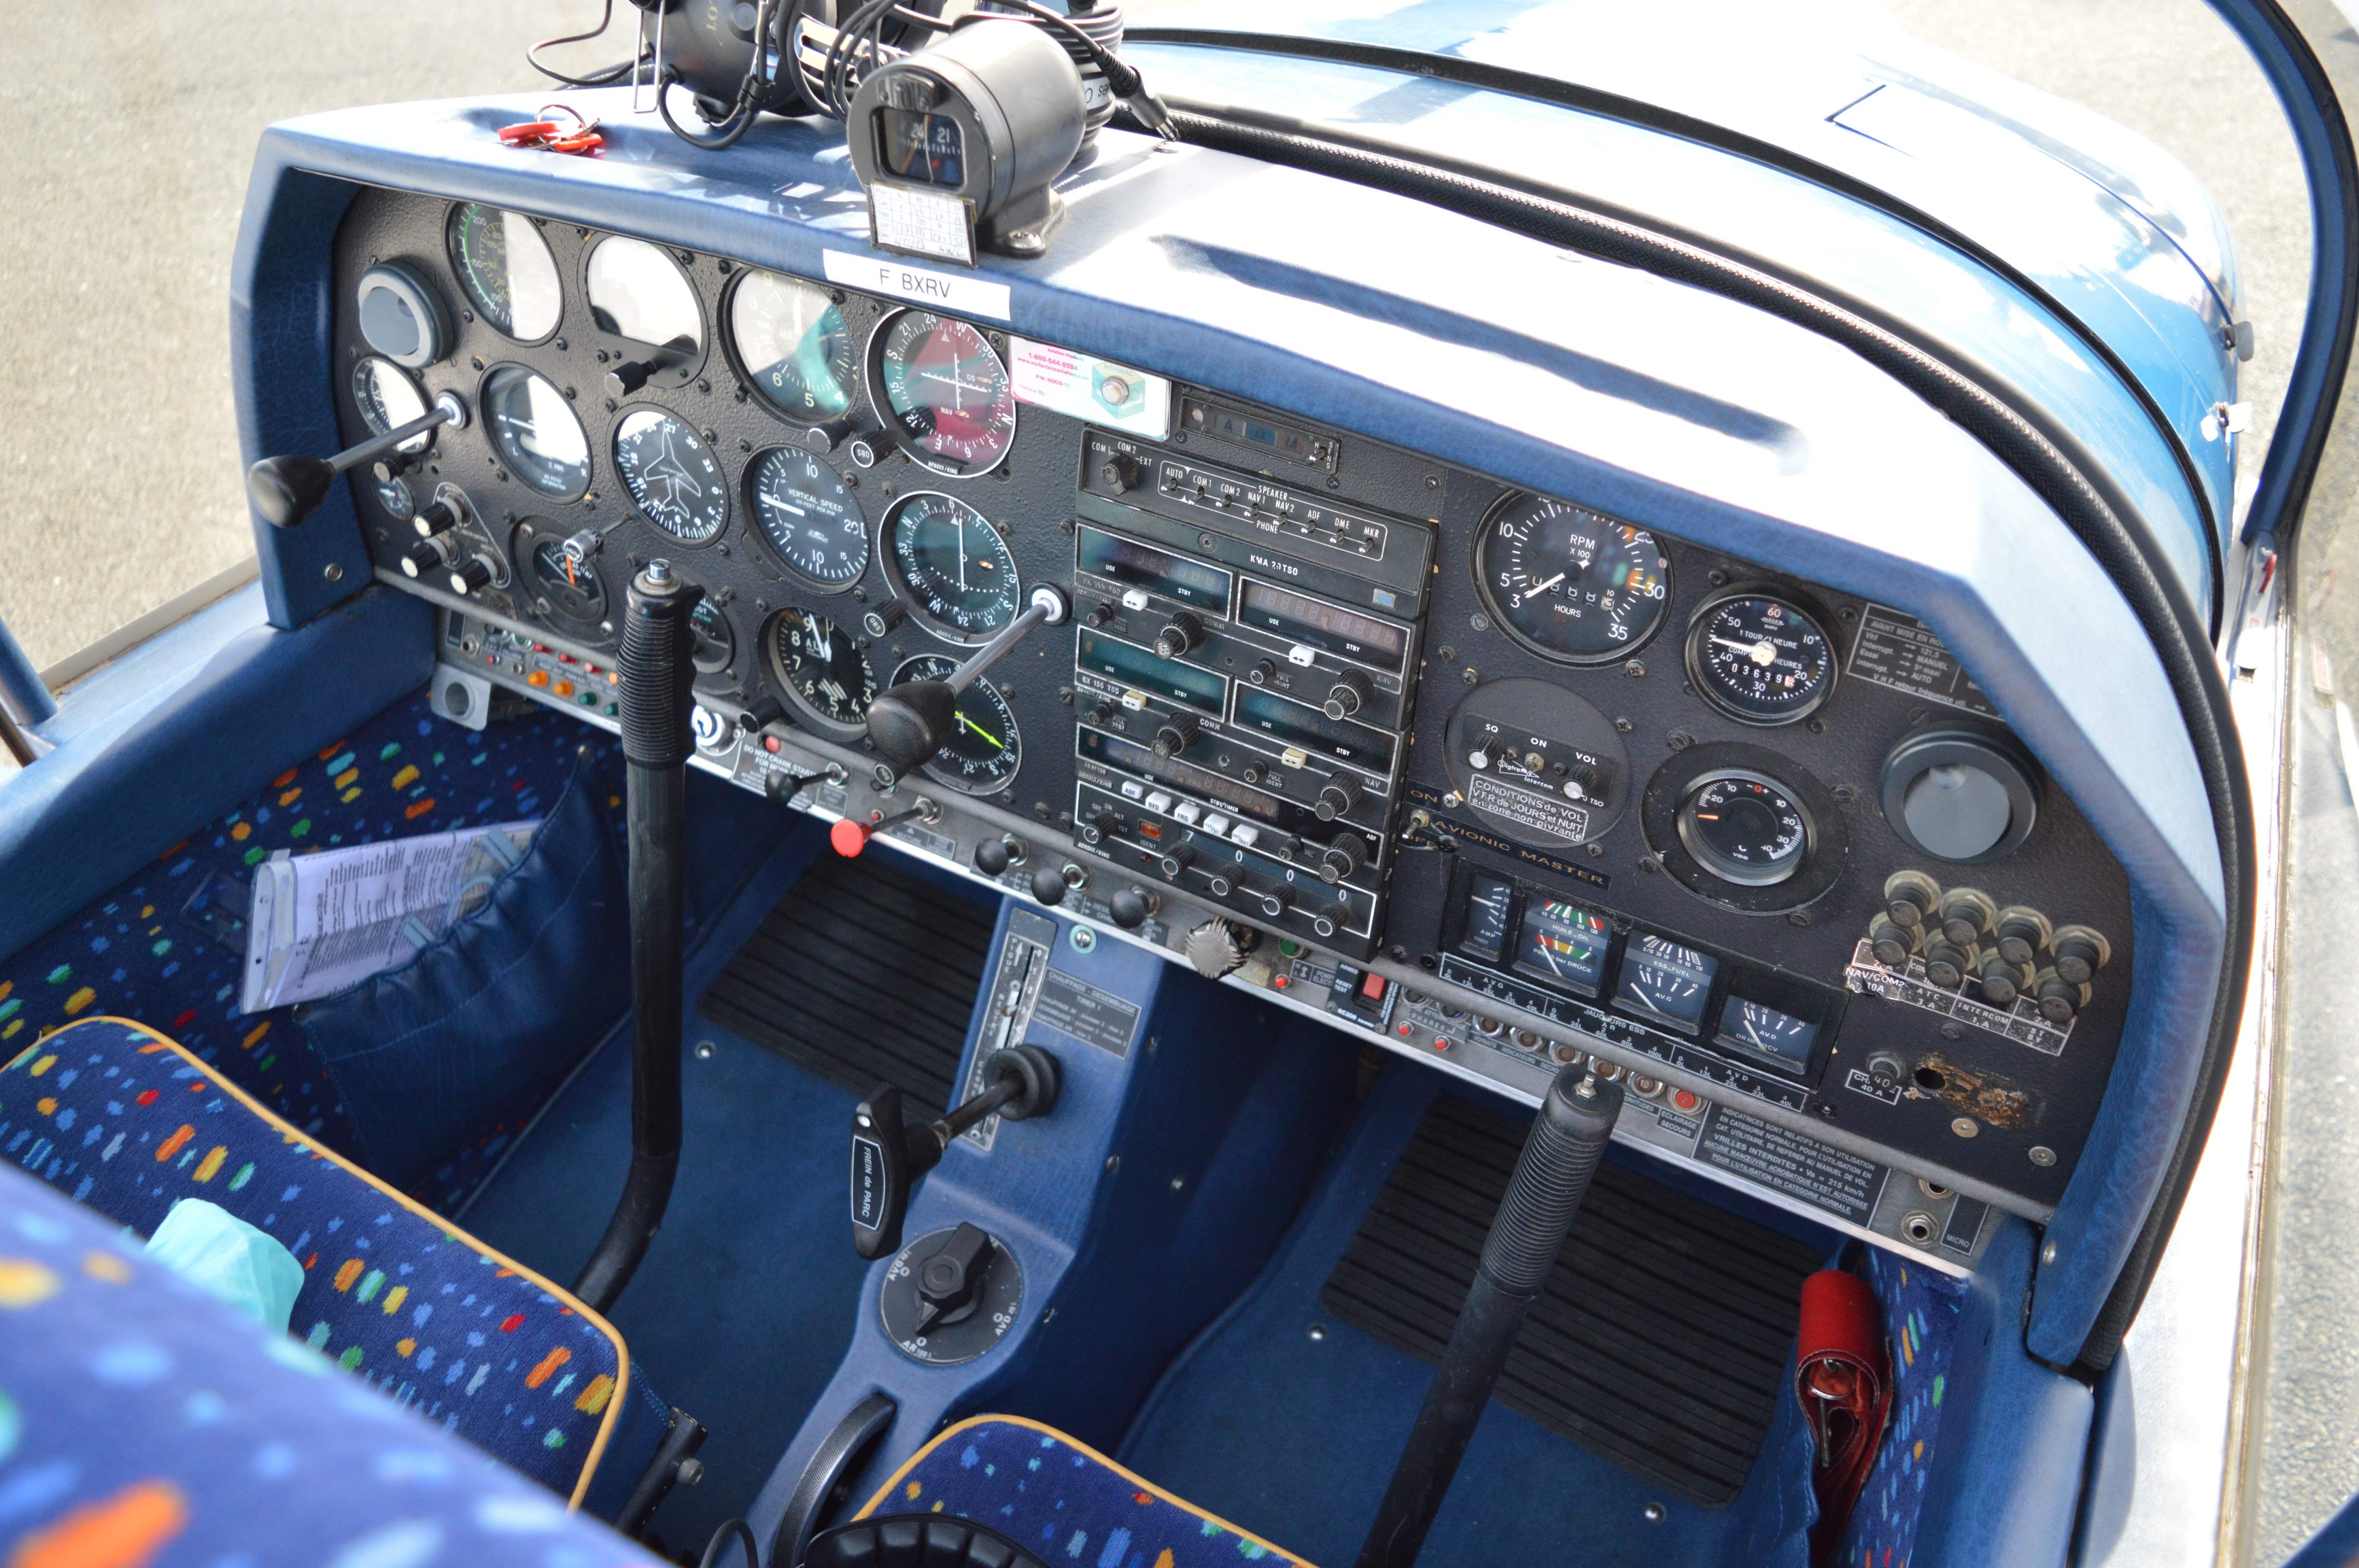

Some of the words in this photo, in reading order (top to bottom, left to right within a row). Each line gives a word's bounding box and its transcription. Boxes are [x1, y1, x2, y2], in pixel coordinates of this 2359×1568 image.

[938, 127, 949, 143] 21
[472, 216, 486, 226] 200
[880, 269, 891, 285] F
[902, 274, 951, 299] BXRV
[924, 313, 936, 324] 24
[899, 322, 911, 335] 21
[1029, 353, 1078, 371] 1-800-544-8594
[1104, 364, 1134, 376] NORMAL
[773, 373, 782, 387] 6
[941, 407, 953, 415] NAV
[857, 449, 870, 458] OBS
[1092, 442, 1106, 452] COM
[1118, 442, 1131, 452] COM
[703, 459, 713, 473] 33
[807, 463, 818, 477] 10
[928, 462, 958, 475] BENDIX/KING
[1166, 467, 1183, 479] AUTO
[1193, 475, 1207, 486] COM
[1221, 484, 1235, 494] COM
[1259, 486, 1288, 501] SPEAKER
[788, 489, 818, 503] VERTICAL
[821, 500, 842, 512] SPEED
[1248, 492, 1261, 503] NAV
[1275, 500, 1288, 511] NAV
[1308, 510, 1321, 520] ADF
[844, 519, 859, 534] 20
[1257, 520, 1278, 534] PHONE
[1335, 518, 1350, 529] DME
[1499, 522, 1514, 538] 10
[1364, 527, 1379, 538] MKR
[1570, 534, 1595, 550] RPM
[899, 543, 908, 555] 33
[1577, 549, 1590, 559] 100
[1250, 554, 1268, 567] KMA
[1282, 564, 1298, 576] TSO
[1500, 573, 1510, 587] 5
[1178, 588, 1191, 596] STBY
[1644, 582, 1665, 600] 30
[1554, 604, 1581, 618] HOURS
[1767, 608, 1781, 617] 60
[870, 617, 881, 631] OBS
[1728, 617, 1741, 627] 50
[1608, 624, 1627, 640] 35
[1871, 621, 1895, 632] AVANT
[1896, 628, 1915, 640] MISE
[792, 631, 800, 646] 8
[1745, 631, 1763, 640] TOUR
[1773, 638, 1798, 649] HEURE
[1804, 635, 1814, 644] 10
[1346, 643, 1360, 652] STBY
[793, 655, 801, 670] 7
[1774, 658, 1802, 670] HEURES
[1917, 656, 1948, 670] MANUEL
[1911, 673, 1932, 683] AUTO
[1083, 676, 1091, 684] KX
[1094, 680, 1104, 689] 155
[1108, 685, 1119, 694] TSO
[1753, 681, 1766, 691] 30
[1174, 690, 1187, 698] STBY
[1895, 681, 1917, 691] retour
[1917, 687, 1954, 703] fréquence
[1200, 718, 1220, 731] COMM
[1486, 724, 1498, 733] SQ
[1531, 738, 1547, 747] ON
[744, 745, 754, 753] DO
[755, 749, 768, 759] NOT
[770, 754, 792, 768] CRANK
[1336, 747, 1350, 756] STBY
[1576, 753, 1596, 765] VOL
[880, 768, 890, 781] HDG
[1268, 773, 1281, 782] PULL
[1266, 779, 1282, 789] IDENT
[1365, 778, 1380, 788] NAV
[1524, 777, 1553, 790] Intercom
[1411, 790, 1437, 802] ON
[1475, 780, 1543, 808] CONDITIONS
[1544, 804, 1556, 814] de
[1561, 809, 1582, 822] VOL
[1590, 798, 1603, 807] TSO
[1148, 802, 1159, 810] BFO
[1210, 798, 1238, 813] STBY/TIMER
[1488, 803, 1512, 817] zone
[1514, 811, 1533, 824] non
[1537, 819, 1582, 840] givrante
[1511, 799, 1546, 820] JOURS
[1547, 815, 1556, 824] et
[1558, 817, 1582, 832] NUIT
[1140, 840, 1156, 849] IDENT
[1777, 836, 1789, 844] 30
[1078, 842, 1110, 859] BENDIX/KING
[1435, 821, 1511, 851] AVIONIC
[1521, 850, 1603, 884] MASTER
[1480, 929, 1496, 938] AMP
[1340, 964, 1358, 974] ARMED
[1555, 956, 1566, 965] bar
[1567, 960, 1591, 973] DRÜCK
[1049, 972, 1086, 992] CHAUFFAGE
[1336, 979, 1352, 989] RESET
[1845, 968, 1905, 988] NAV/COM2
[1867, 982, 1884, 993] 10A
[1077, 996, 1096, 1008] TIRER
[1338, 1008, 1357, 1020] RC200
[1958, 1003, 2009, 1024] INTERCOM
[1647, 1050, 1663, 1060] 100L
[1861, 1083, 1873, 1092] 40
[1662, 1111, 1697, 1129] ECLAIRAGE
[1661, 1120, 1691, 1136] SECOURS
[1723, 1108, 1764, 1128] INDICATRICES
[1784, 1130, 1813, 1146] RELATIFS
[1837, 1151, 1875, 1170] UTILISATION
[1730, 1120, 1764, 1137] CATEGORIE
[1799, 1146, 1816, 1156] POUR
[1704, 1140, 1728, 1154] AUCUNE
[1768, 1164, 1812, 1186] ACROBATIQUE
[1715, 1133, 1747, 1151] VRILLES
[1749, 1144, 1797, 1170] INTERDITES
[1806, 1169, 1815, 1178] Va
[1829, 1179, 1842, 1189] 215
[1844, 1184, 1864, 1198] km/h
[1777, 1146, 1804, 1162] REFERER
[1817, 1162, 1842, 1177] MANUEL
[865, 1176, 871, 1188] de
[862, 1191, 871, 1217] PARC
[1946, 1234, 1969, 1248] MICRO
[889, 1260, 904, 1281] AVG
[995, 1316, 1011, 1336] AVD
